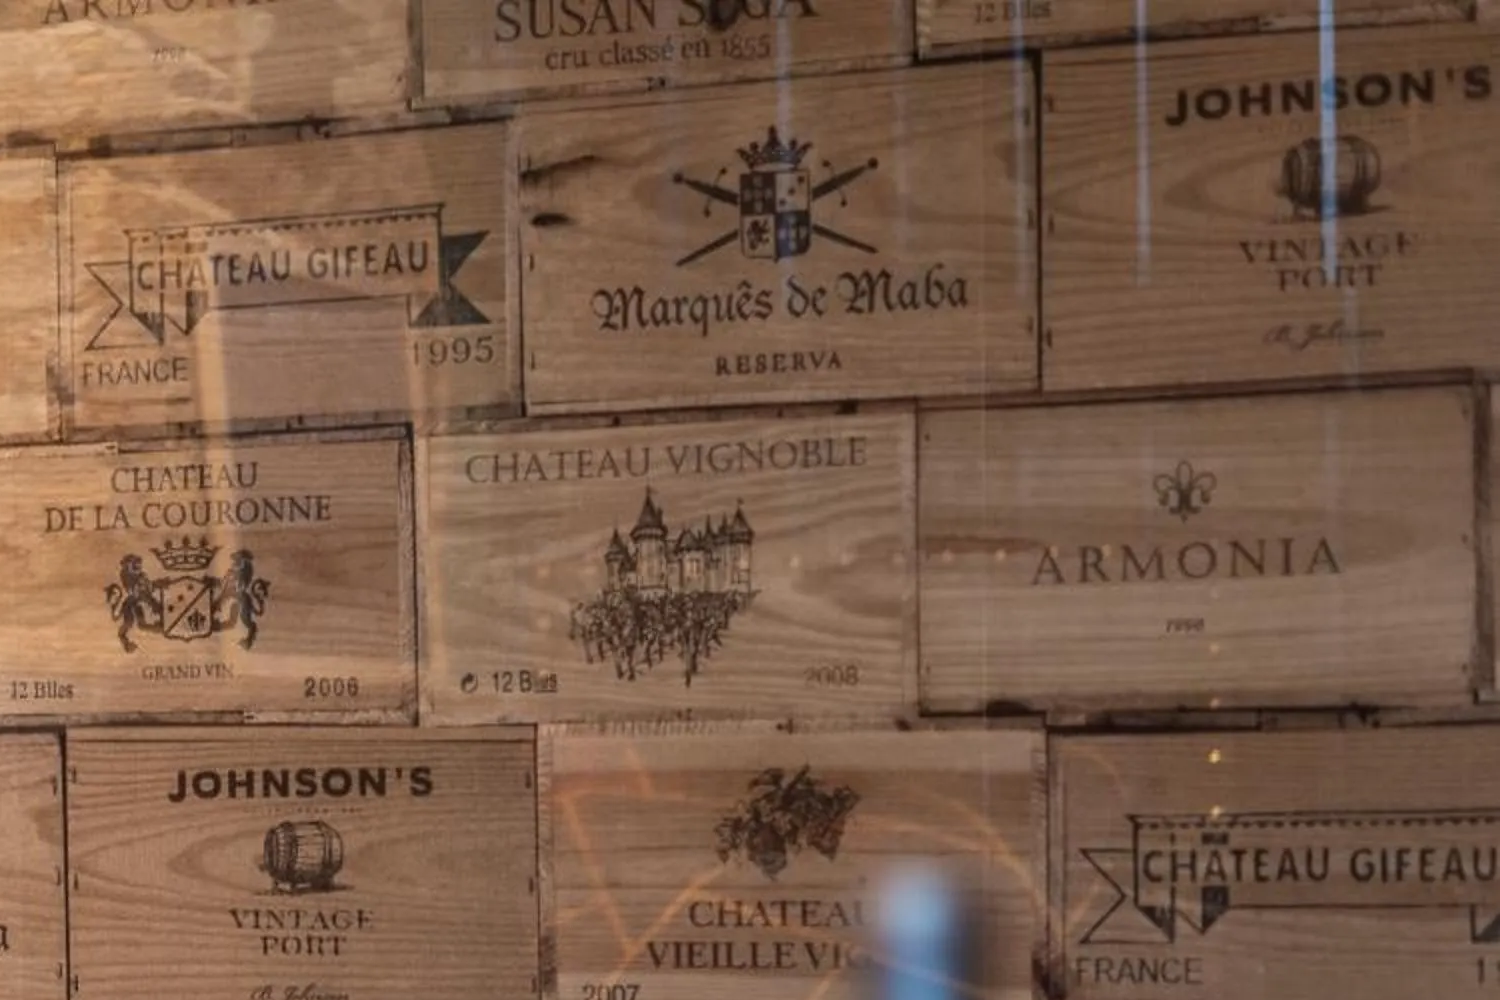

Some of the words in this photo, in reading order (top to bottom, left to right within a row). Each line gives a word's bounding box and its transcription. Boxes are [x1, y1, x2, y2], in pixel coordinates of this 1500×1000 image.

[545, 50, 589, 71] cru
[680, 38, 711, 60] en
[1165, 65, 1492, 127] JOHNSON'S
[1238, 232, 1419, 263] VINTAGE
[135, 242, 292, 291] CHATEAU
[307, 241, 429, 278] GIFEAU
[1276, 263, 1383, 291] PORT
[593, 280, 773, 337] Marquês
[787, 273, 828, 317] de
[837, 263, 969, 314] Maba
[412, 336, 495, 367] 1995
[715, 350, 842, 376] RESERVA
[82, 357, 189, 387] FRANCE
[464, 447, 652, 484] CHATEAU
[667, 437, 868, 475] VIGNOBLE
[110, 461, 259, 494] CHATEAU
[45, 506, 86, 533] DE
[94, 505, 130, 529] LA
[142, 496, 333, 529] COURONNE
[1032, 536, 1343, 586] ARMONIA
[141, 663, 202, 681] GRAND
[205, 663, 235, 679] VIN
[491, 671, 514, 693] 12
[804, 666, 860, 687] 2008
[10, 681, 30, 700] 12
[168, 766, 434, 802] JOHNSON'S
[1142, 846, 1330, 883] CHATEAU
[1349, 846, 1500, 883] GIFEAU
[229, 908, 374, 931] VINTAGE
[260, 934, 347, 957] PORT
[646, 941, 797, 969] VIEILLE
[1074, 956, 1203, 985] FRANCE
